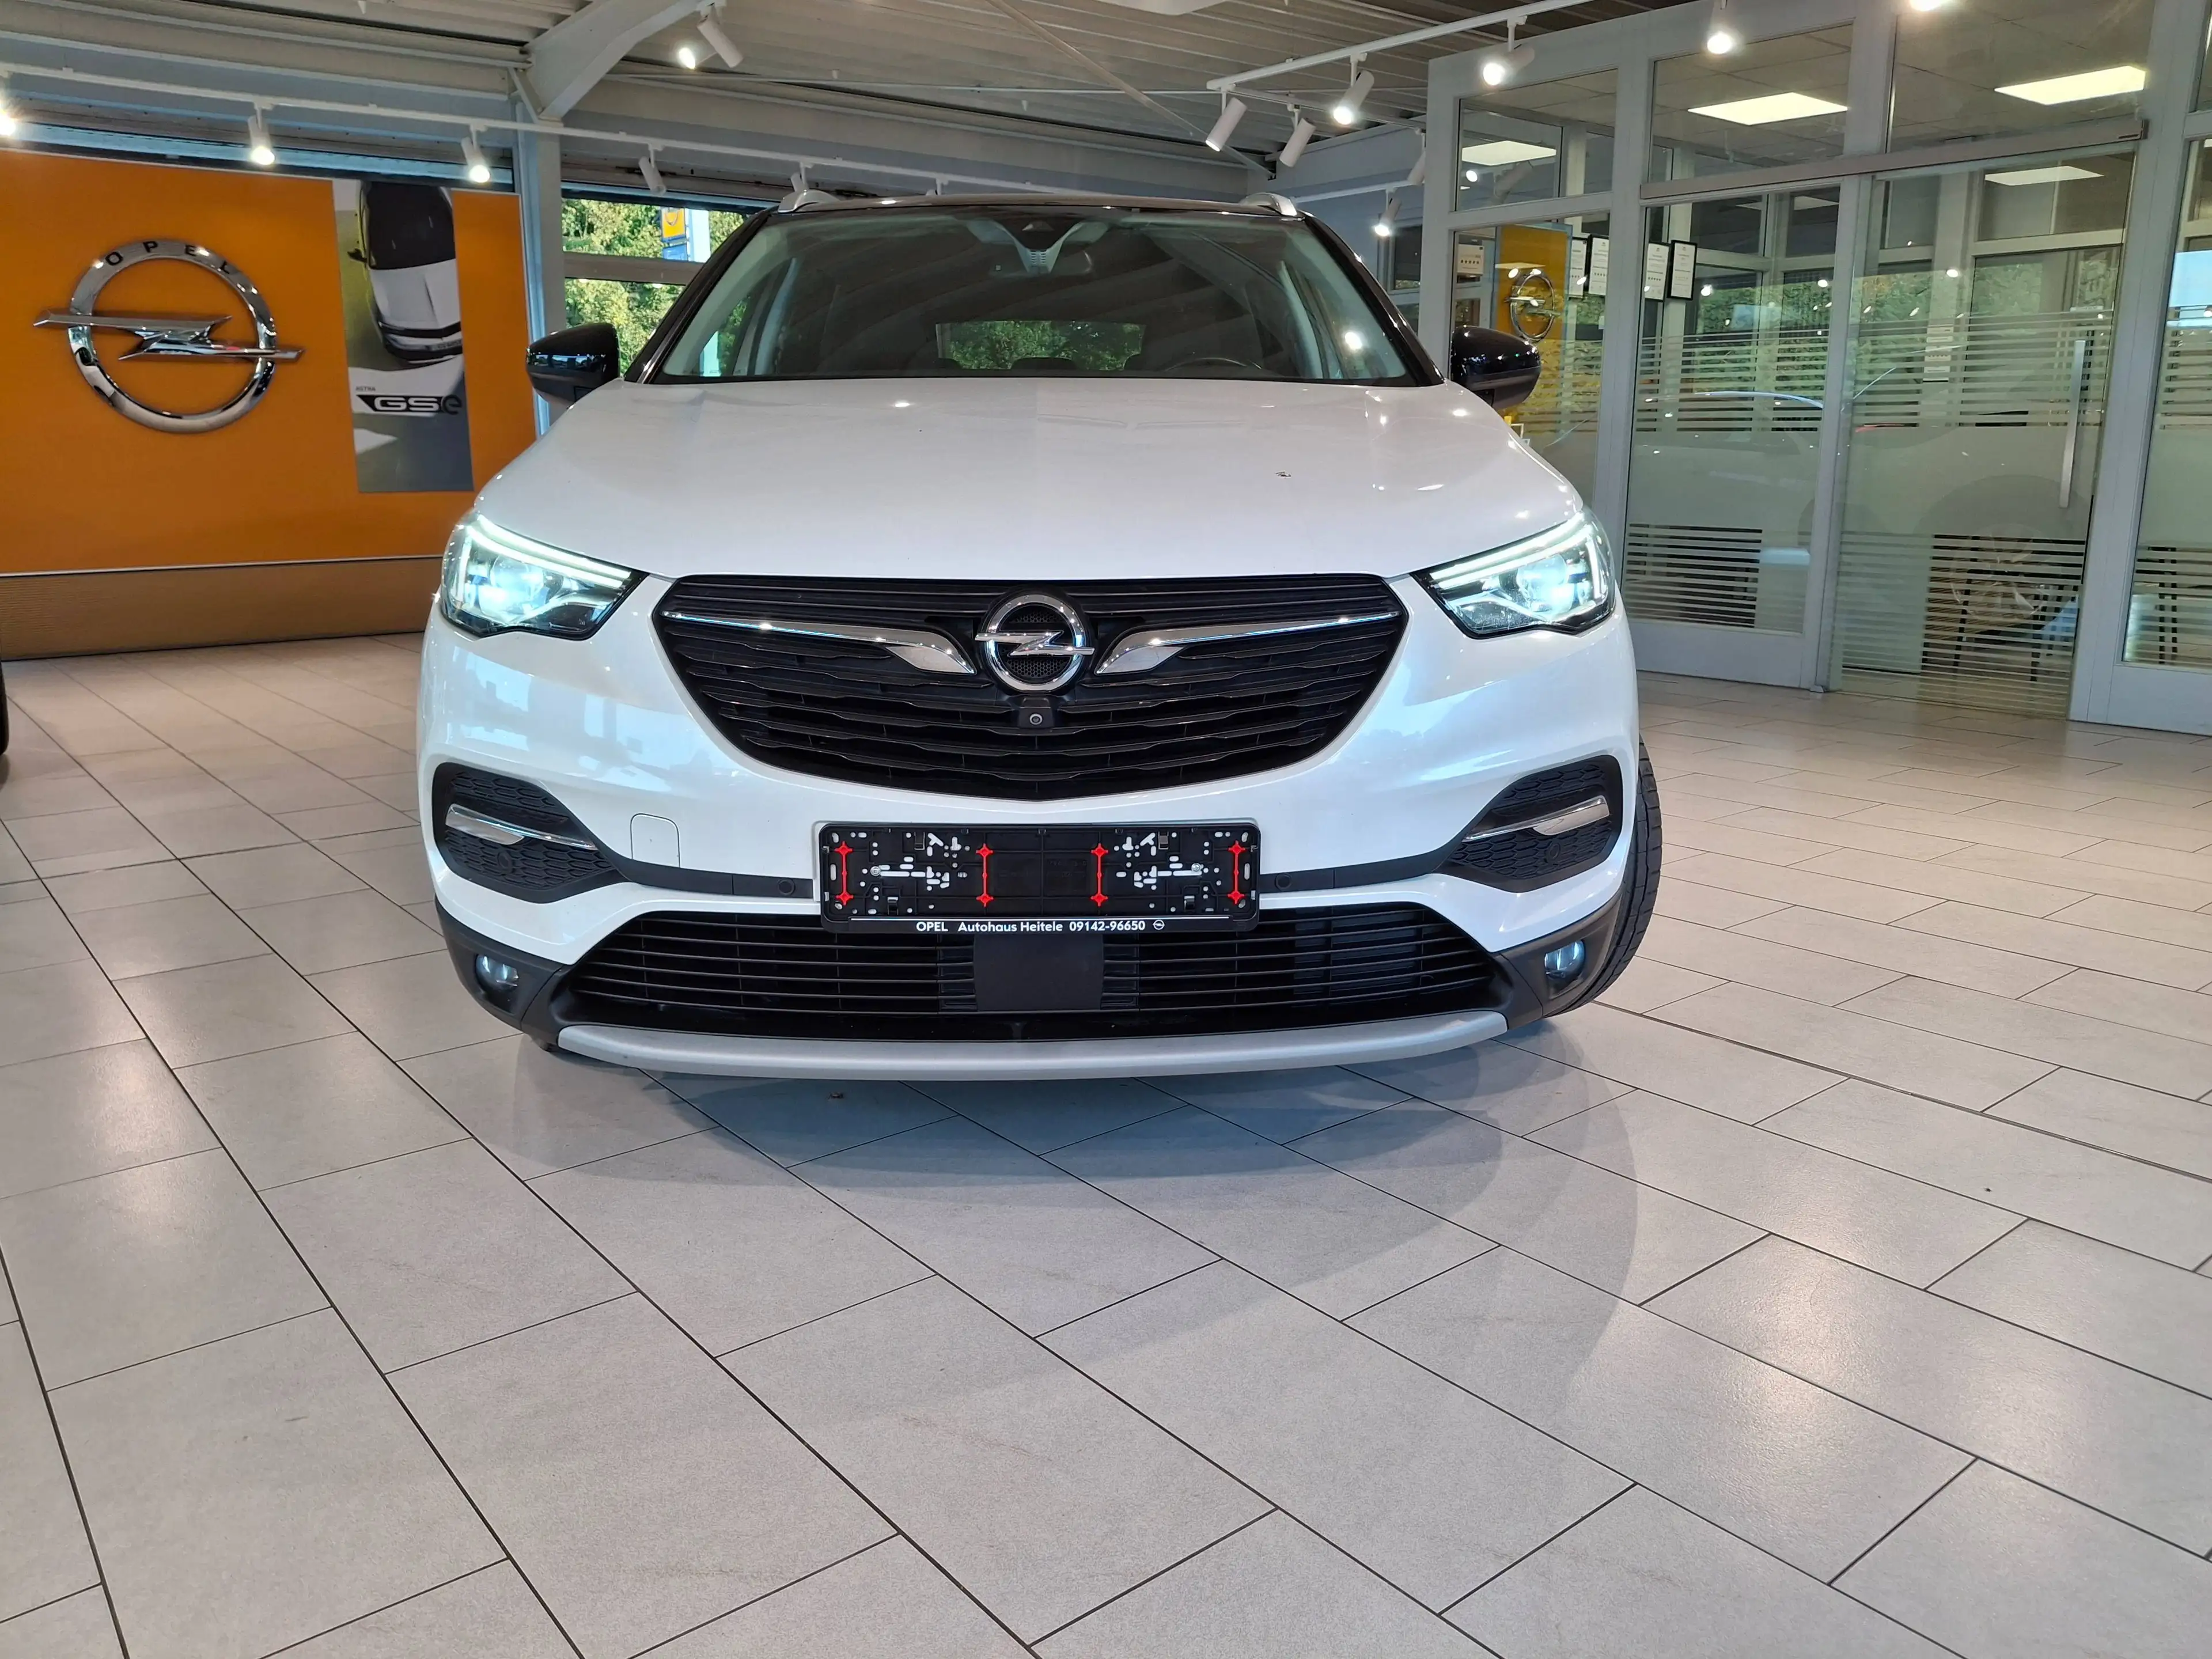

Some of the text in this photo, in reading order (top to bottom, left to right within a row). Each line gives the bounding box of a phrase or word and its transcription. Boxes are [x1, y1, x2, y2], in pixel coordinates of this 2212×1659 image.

[105, 240, 230, 274] OPEL
[916, 921, 1146, 932] OPEL Autohaus Heitele 09142-96650
